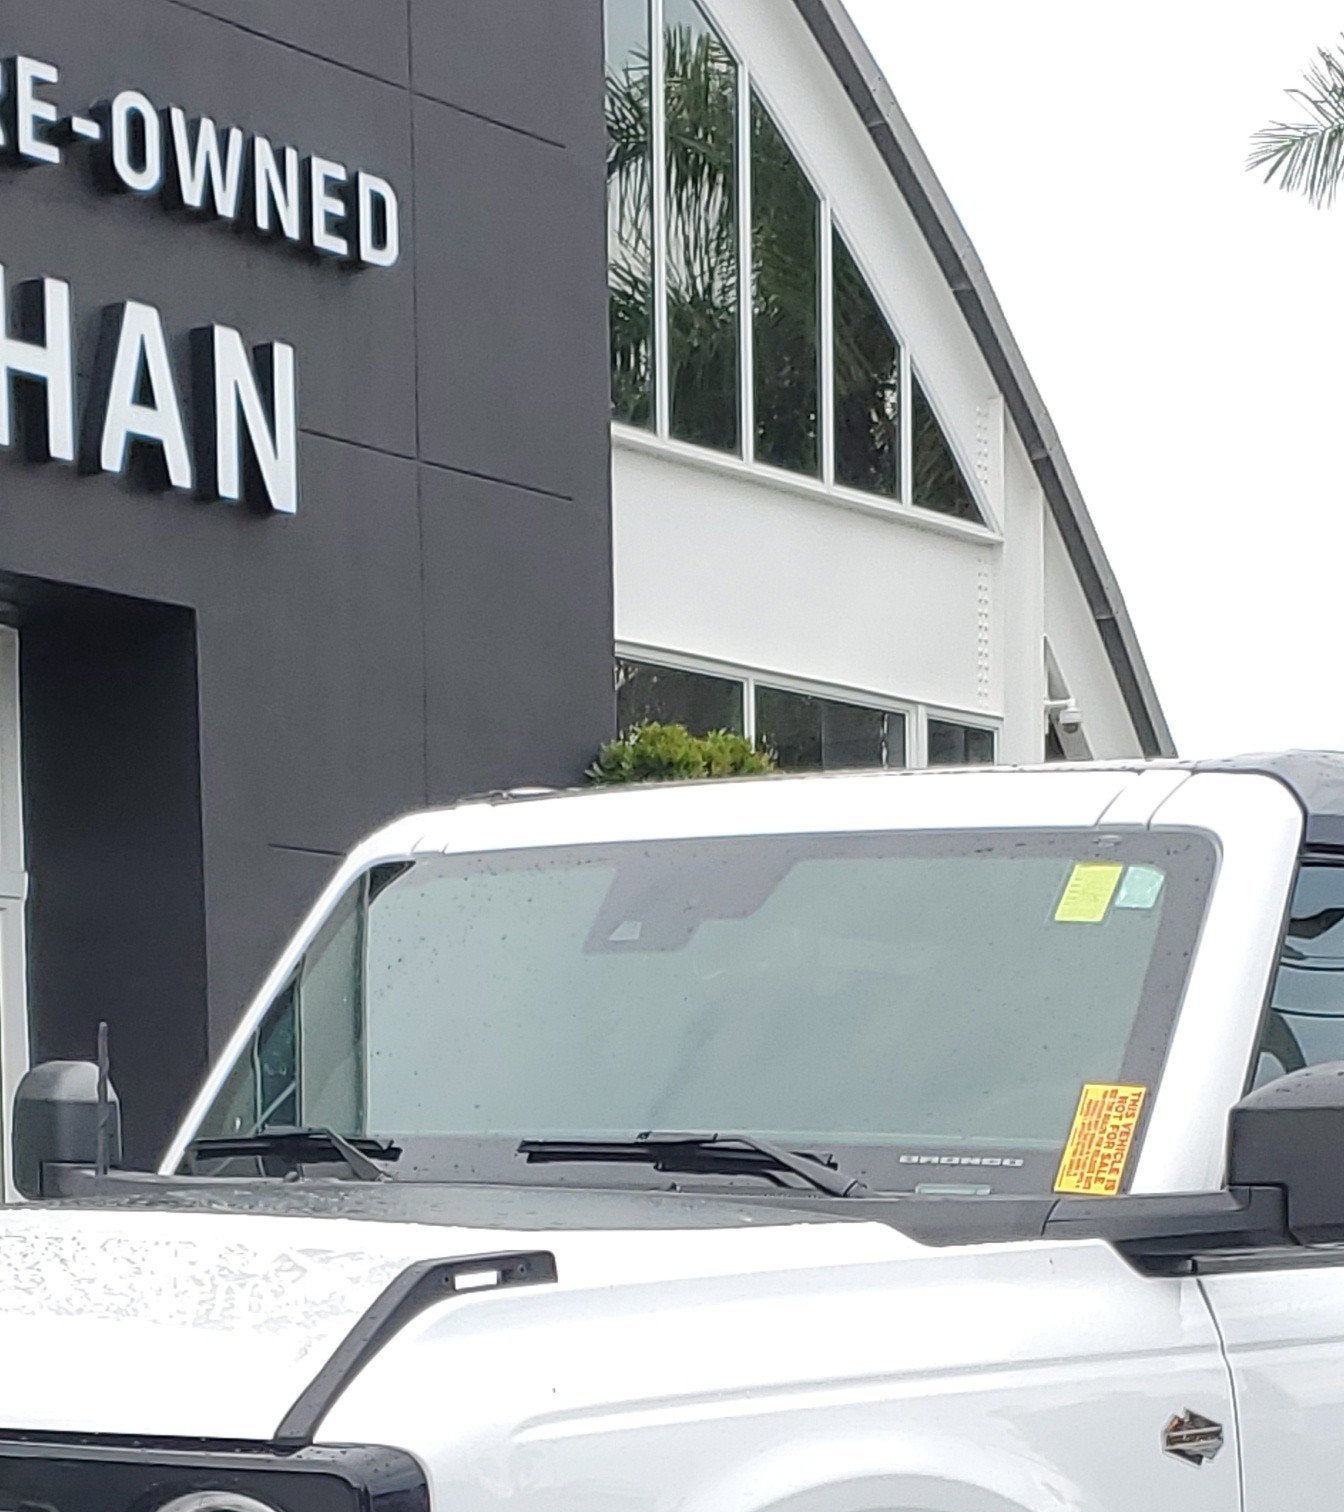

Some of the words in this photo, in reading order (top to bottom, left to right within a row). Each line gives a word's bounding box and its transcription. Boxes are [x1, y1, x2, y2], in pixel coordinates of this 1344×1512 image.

[1113, 1096, 1129, 1121] NOT
[1125, 1091, 1142, 1119] THIS
[1103, 1124, 1120, 1149] FOR
[1108, 1122, 1134, 1175] VEHICLE
[1094, 1152, 1112, 1184] SALE
[1104, 1179, 1117, 1191] IS
